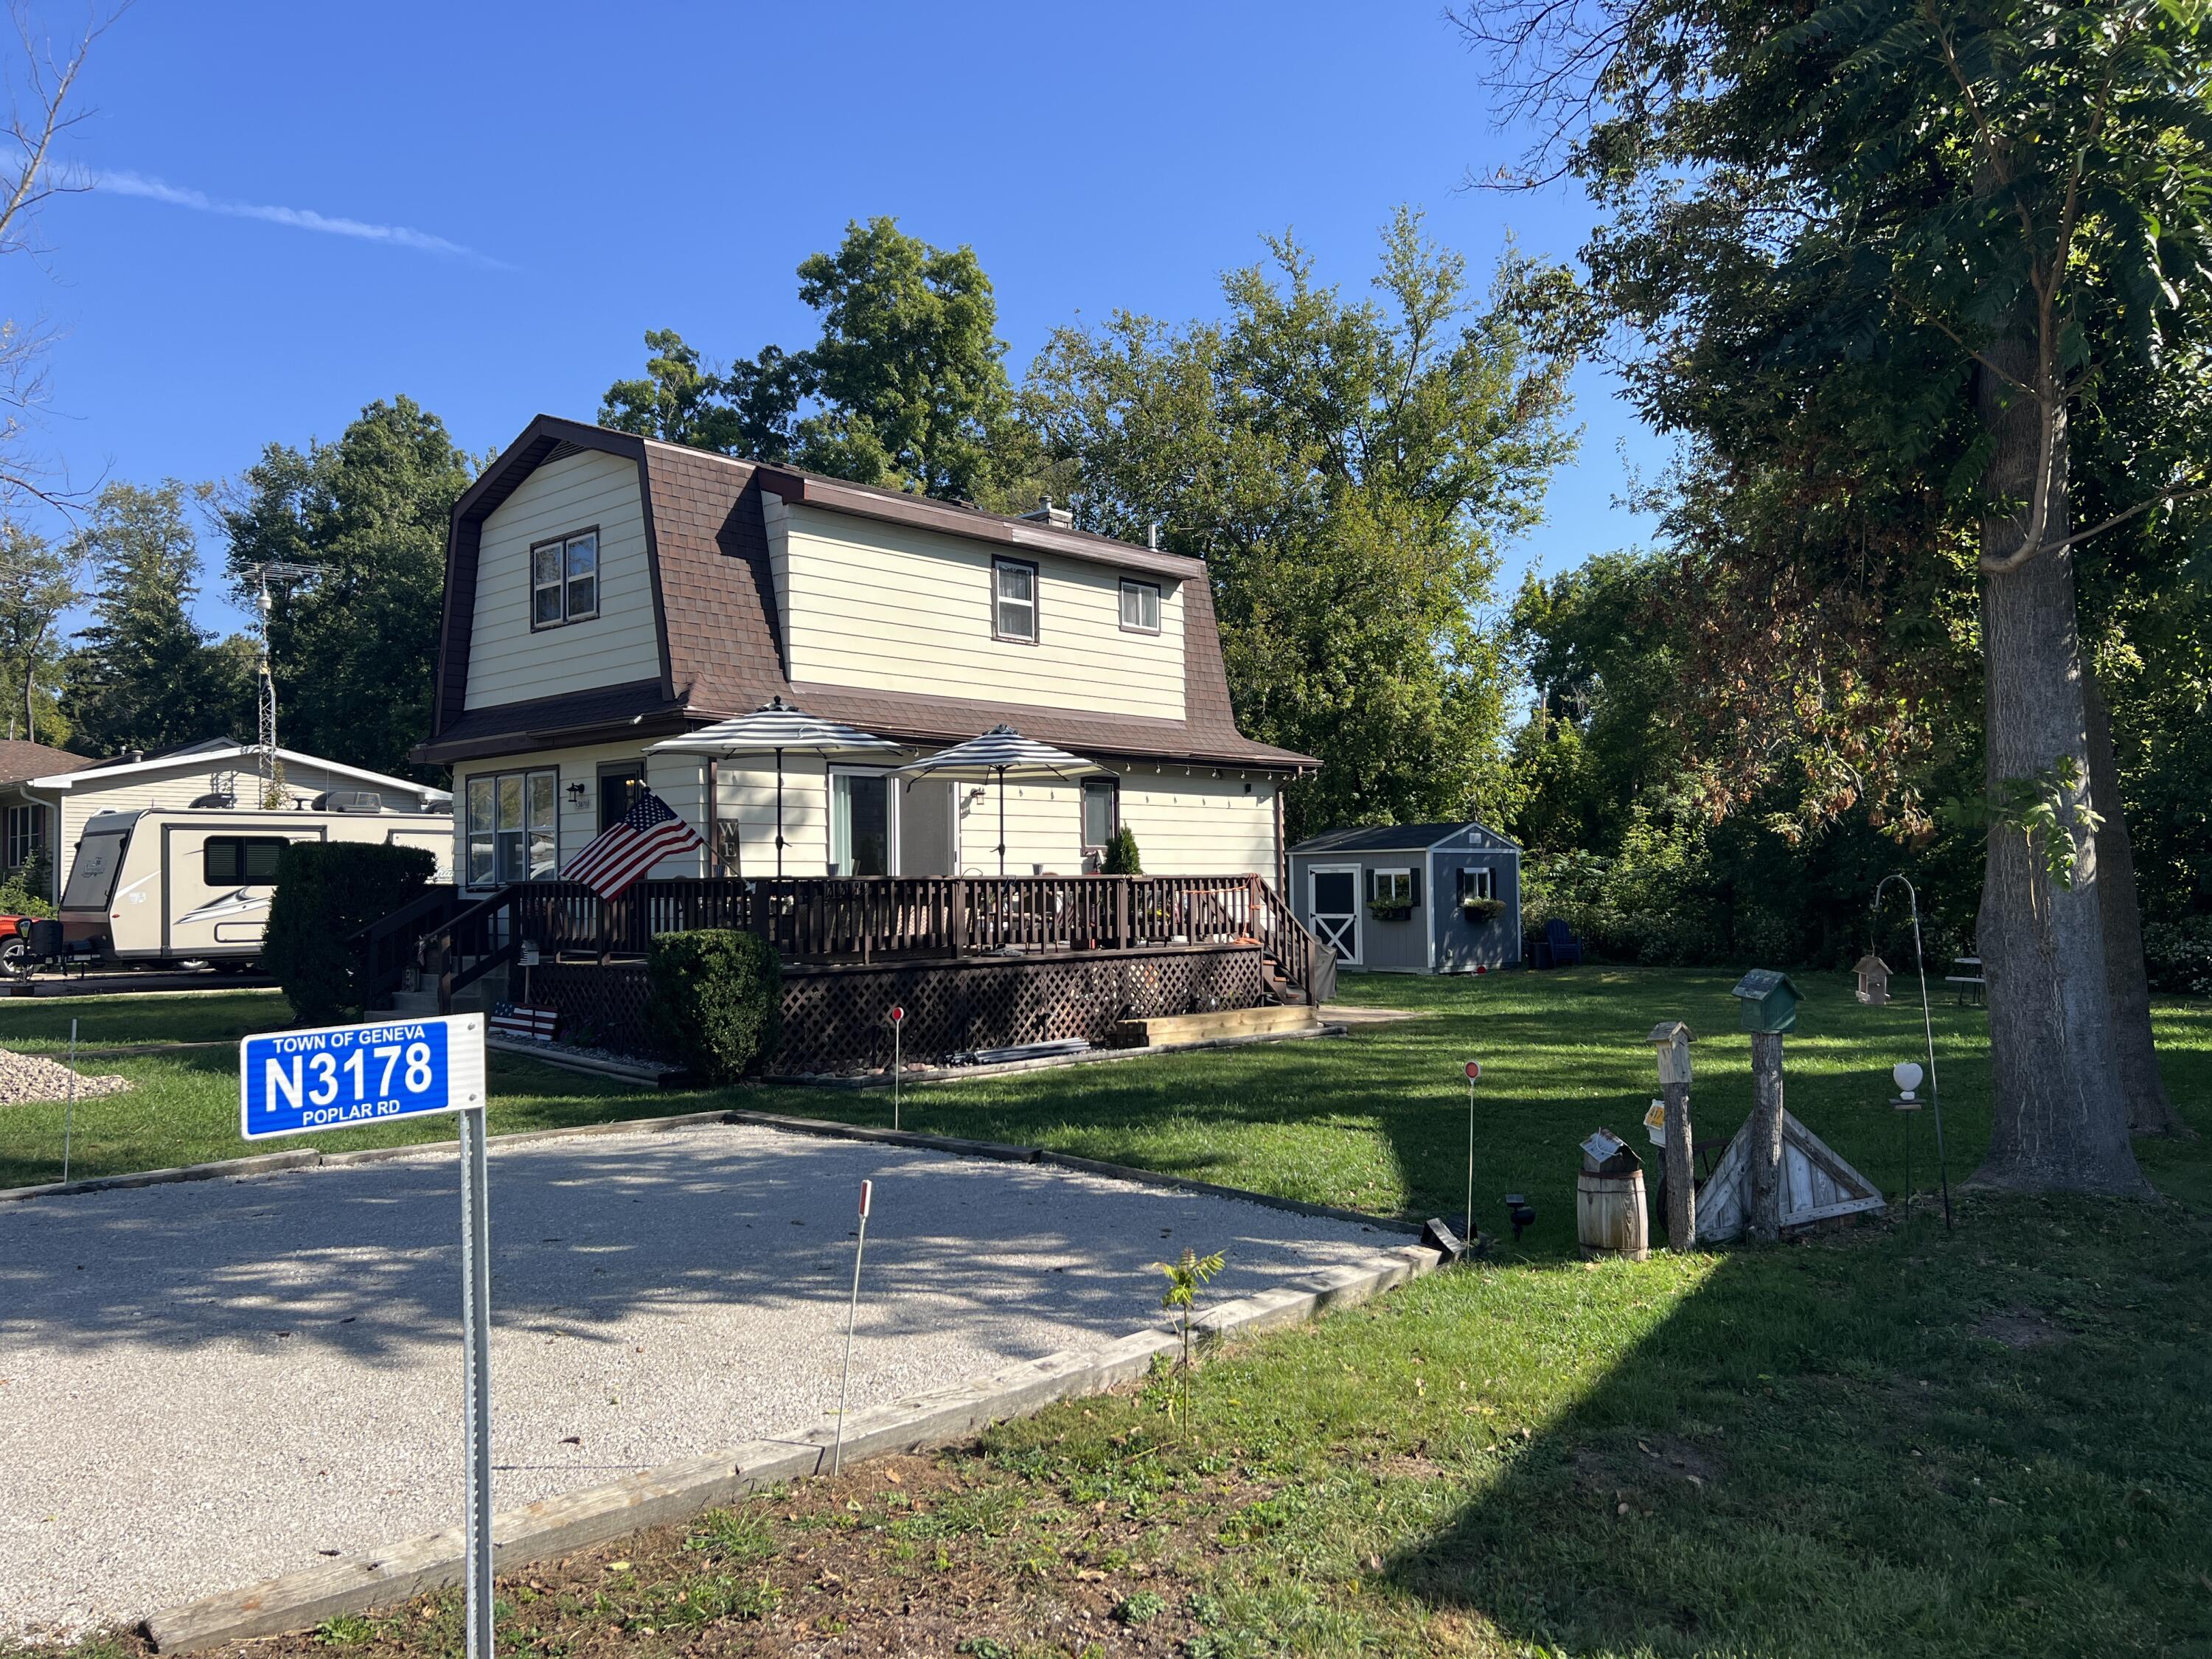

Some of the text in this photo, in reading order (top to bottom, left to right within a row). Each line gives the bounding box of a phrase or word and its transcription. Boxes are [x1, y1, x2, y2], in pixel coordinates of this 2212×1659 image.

[273, 1025, 425, 1054] TOWN OF GENEVA
[265, 1042, 433, 1113] N3178
[302, 1099, 400, 1127] POPLAR RD
